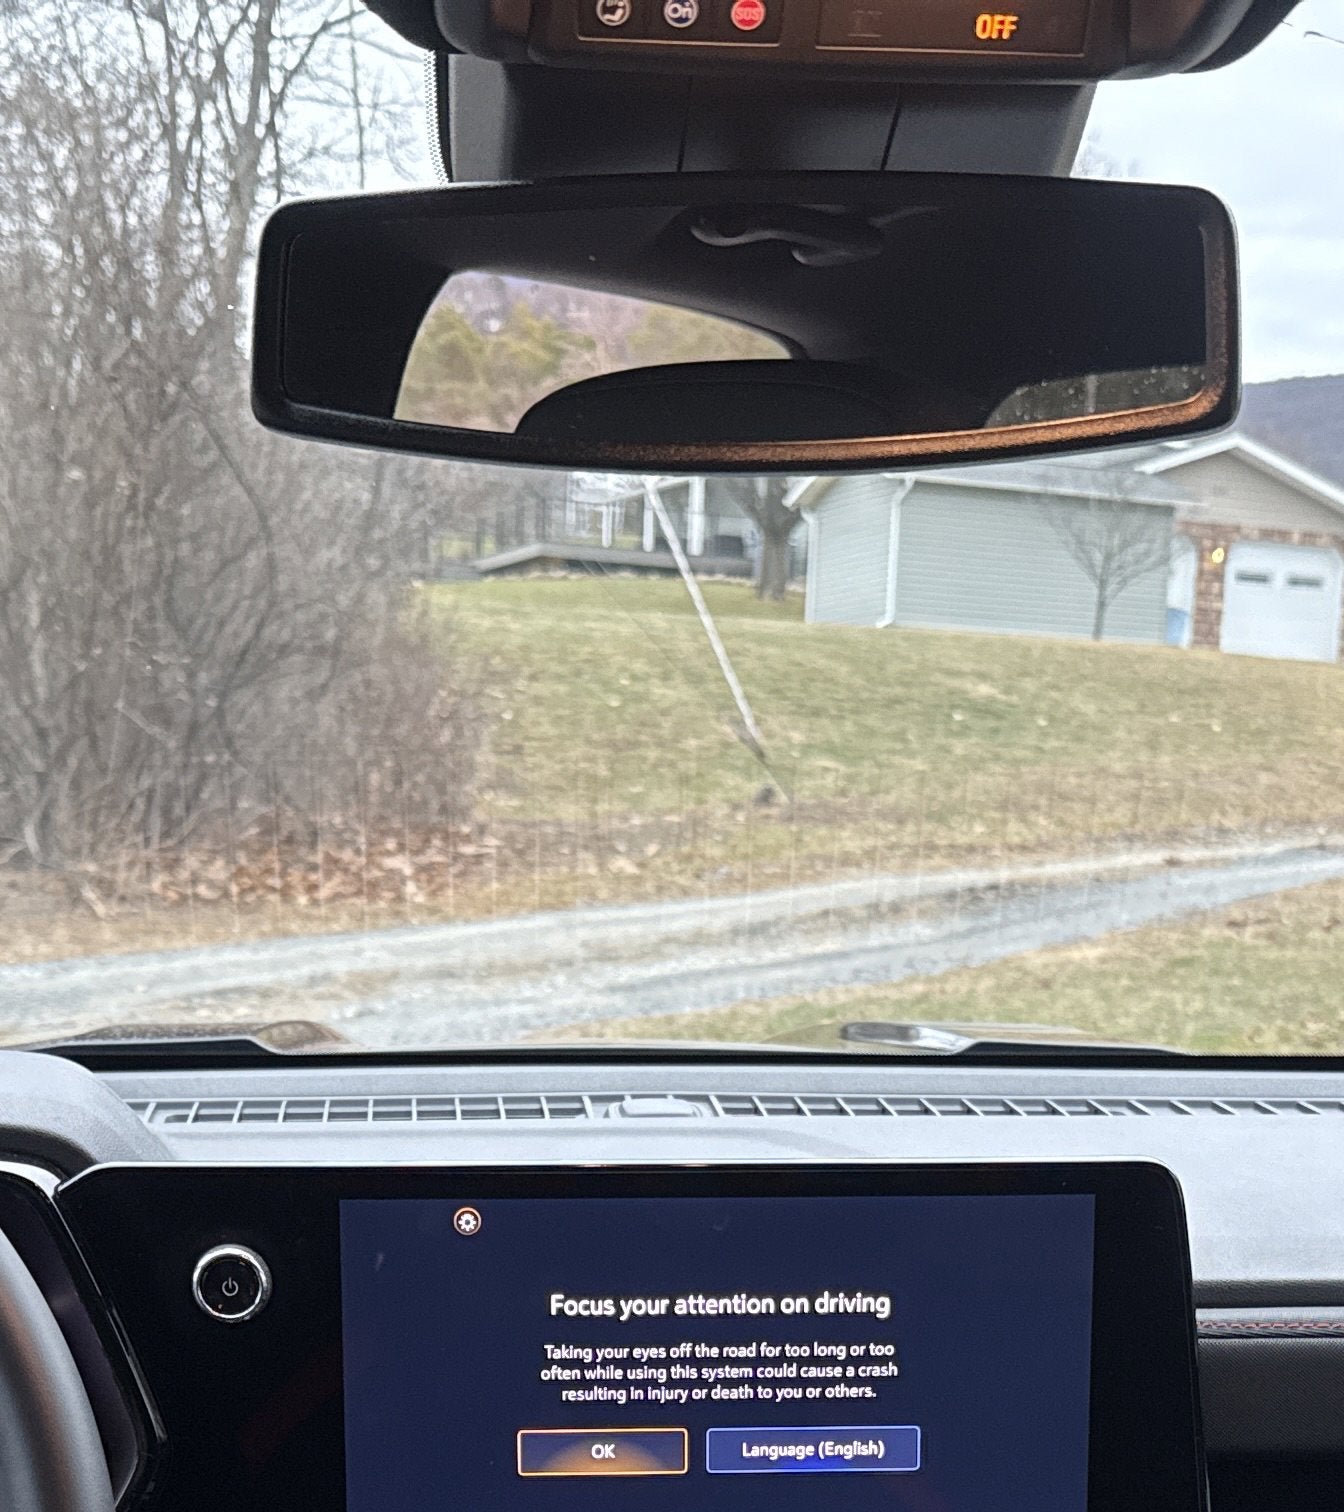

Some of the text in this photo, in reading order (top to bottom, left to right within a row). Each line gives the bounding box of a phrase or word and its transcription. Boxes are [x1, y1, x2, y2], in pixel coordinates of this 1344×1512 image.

[736, 7, 761, 20] SOS
[975, 13, 1019, 40] OFF
[550, 1291, 891, 1321] Focus your attention on driving
[543, 1341, 895, 1362] Taking your eyes off the road for too long or too
[540, 1362, 898, 1382] often while using this system could cause a crash
[561, 1383, 877, 1404] resulting in injury or death to you or others.
[591, 1444, 616, 1459] OK
[742, 1439, 885, 1460] Language (English)
